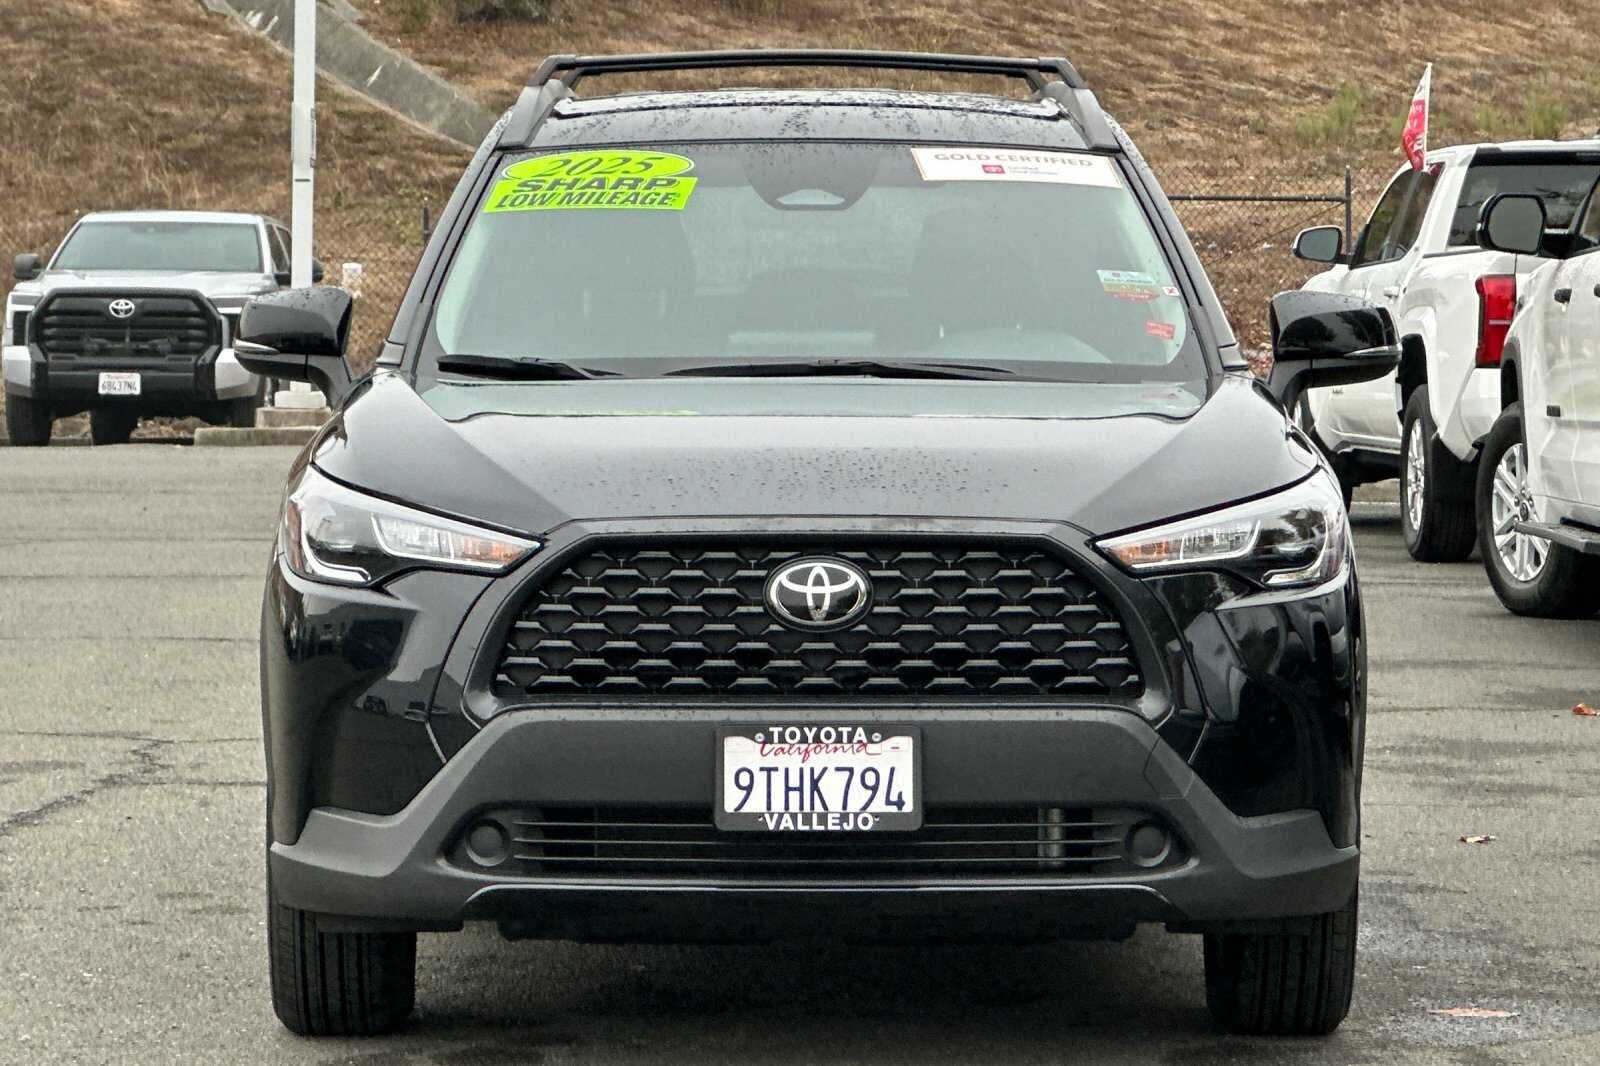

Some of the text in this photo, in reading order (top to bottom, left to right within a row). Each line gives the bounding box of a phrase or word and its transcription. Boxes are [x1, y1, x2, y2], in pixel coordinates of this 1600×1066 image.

[531, 156, 665, 176] 2025
[934, 153, 1094, 167] GOLD CERTIFIED
[512, 177, 681, 193] SHARP
[495, 190, 680, 208] LOW MILEAGE
[769, 726, 868, 744] TOYOTA
[759, 741, 882, 763] California
[734, 766, 906, 812] 9THK794
[764, 813, 874, 831] VALLEJO
